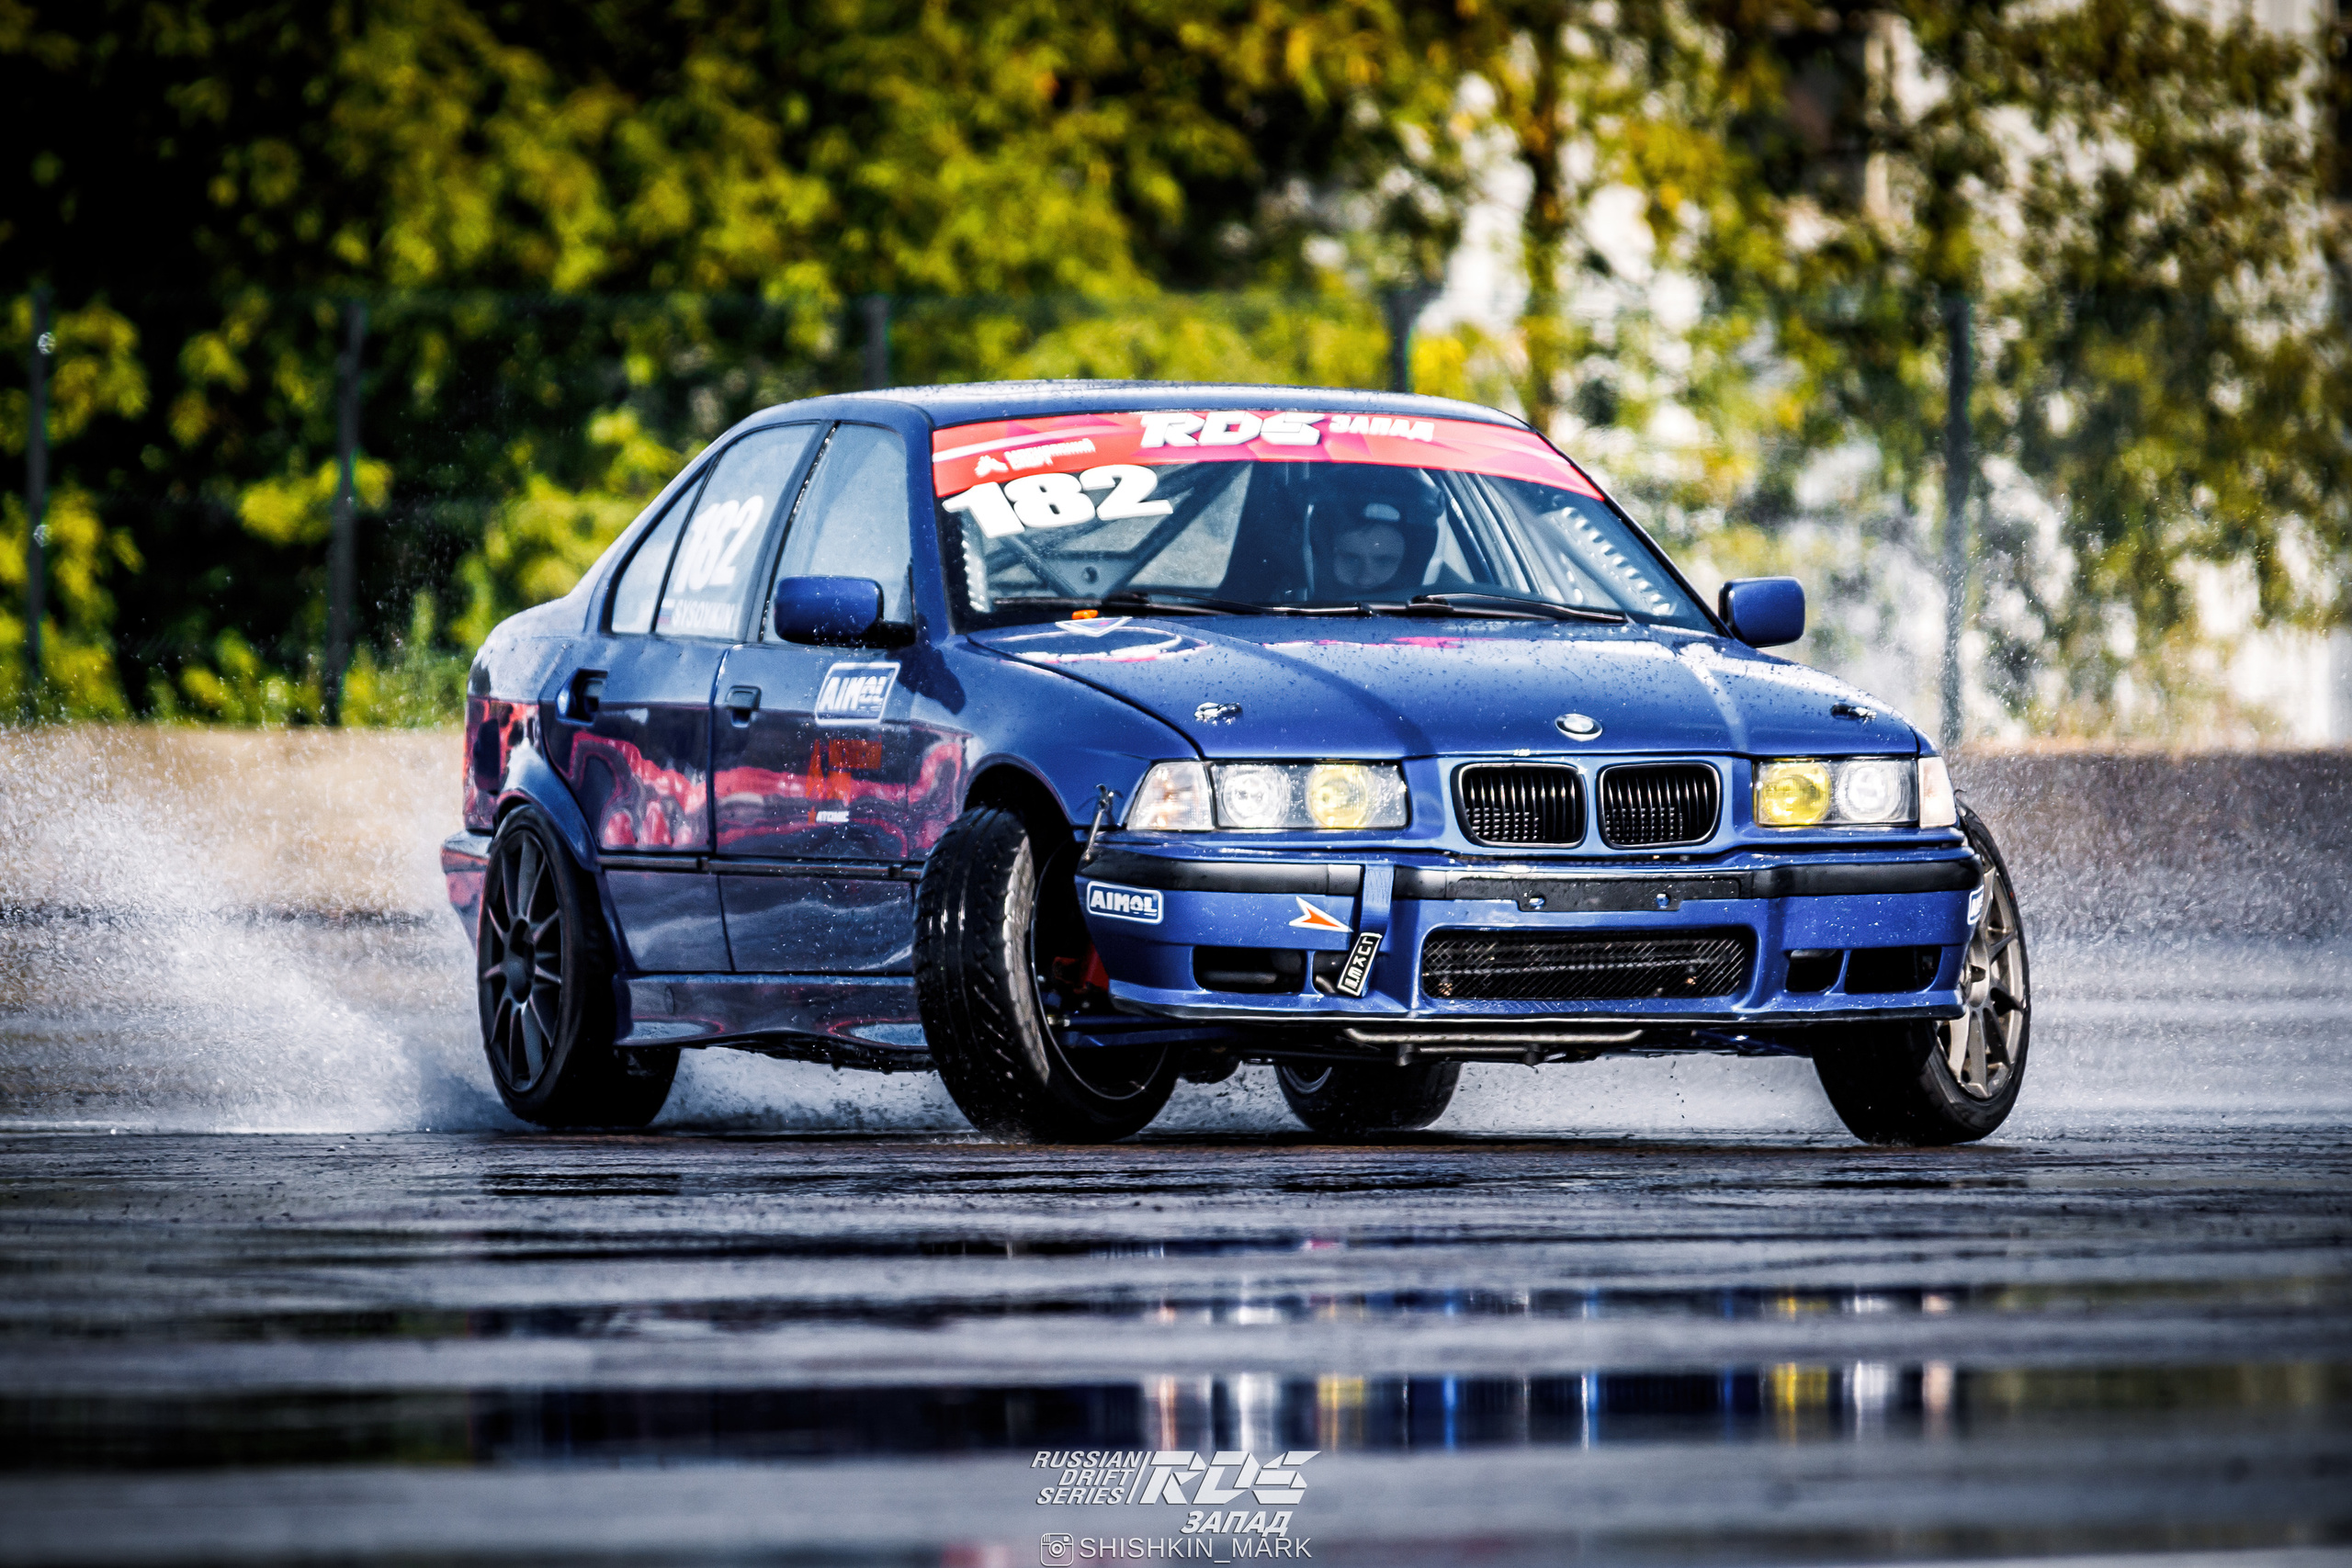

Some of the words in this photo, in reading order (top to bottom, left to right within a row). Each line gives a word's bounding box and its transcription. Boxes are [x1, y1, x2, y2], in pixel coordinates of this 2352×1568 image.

[1140, 412, 1325, 448] RDS
[1329, 414, 1435, 443] ЗАПАД
[943, 464, 1174, 538] 182
[673, 495, 764, 593] 182
[1090, 889, 1158, 917] AIMOL
